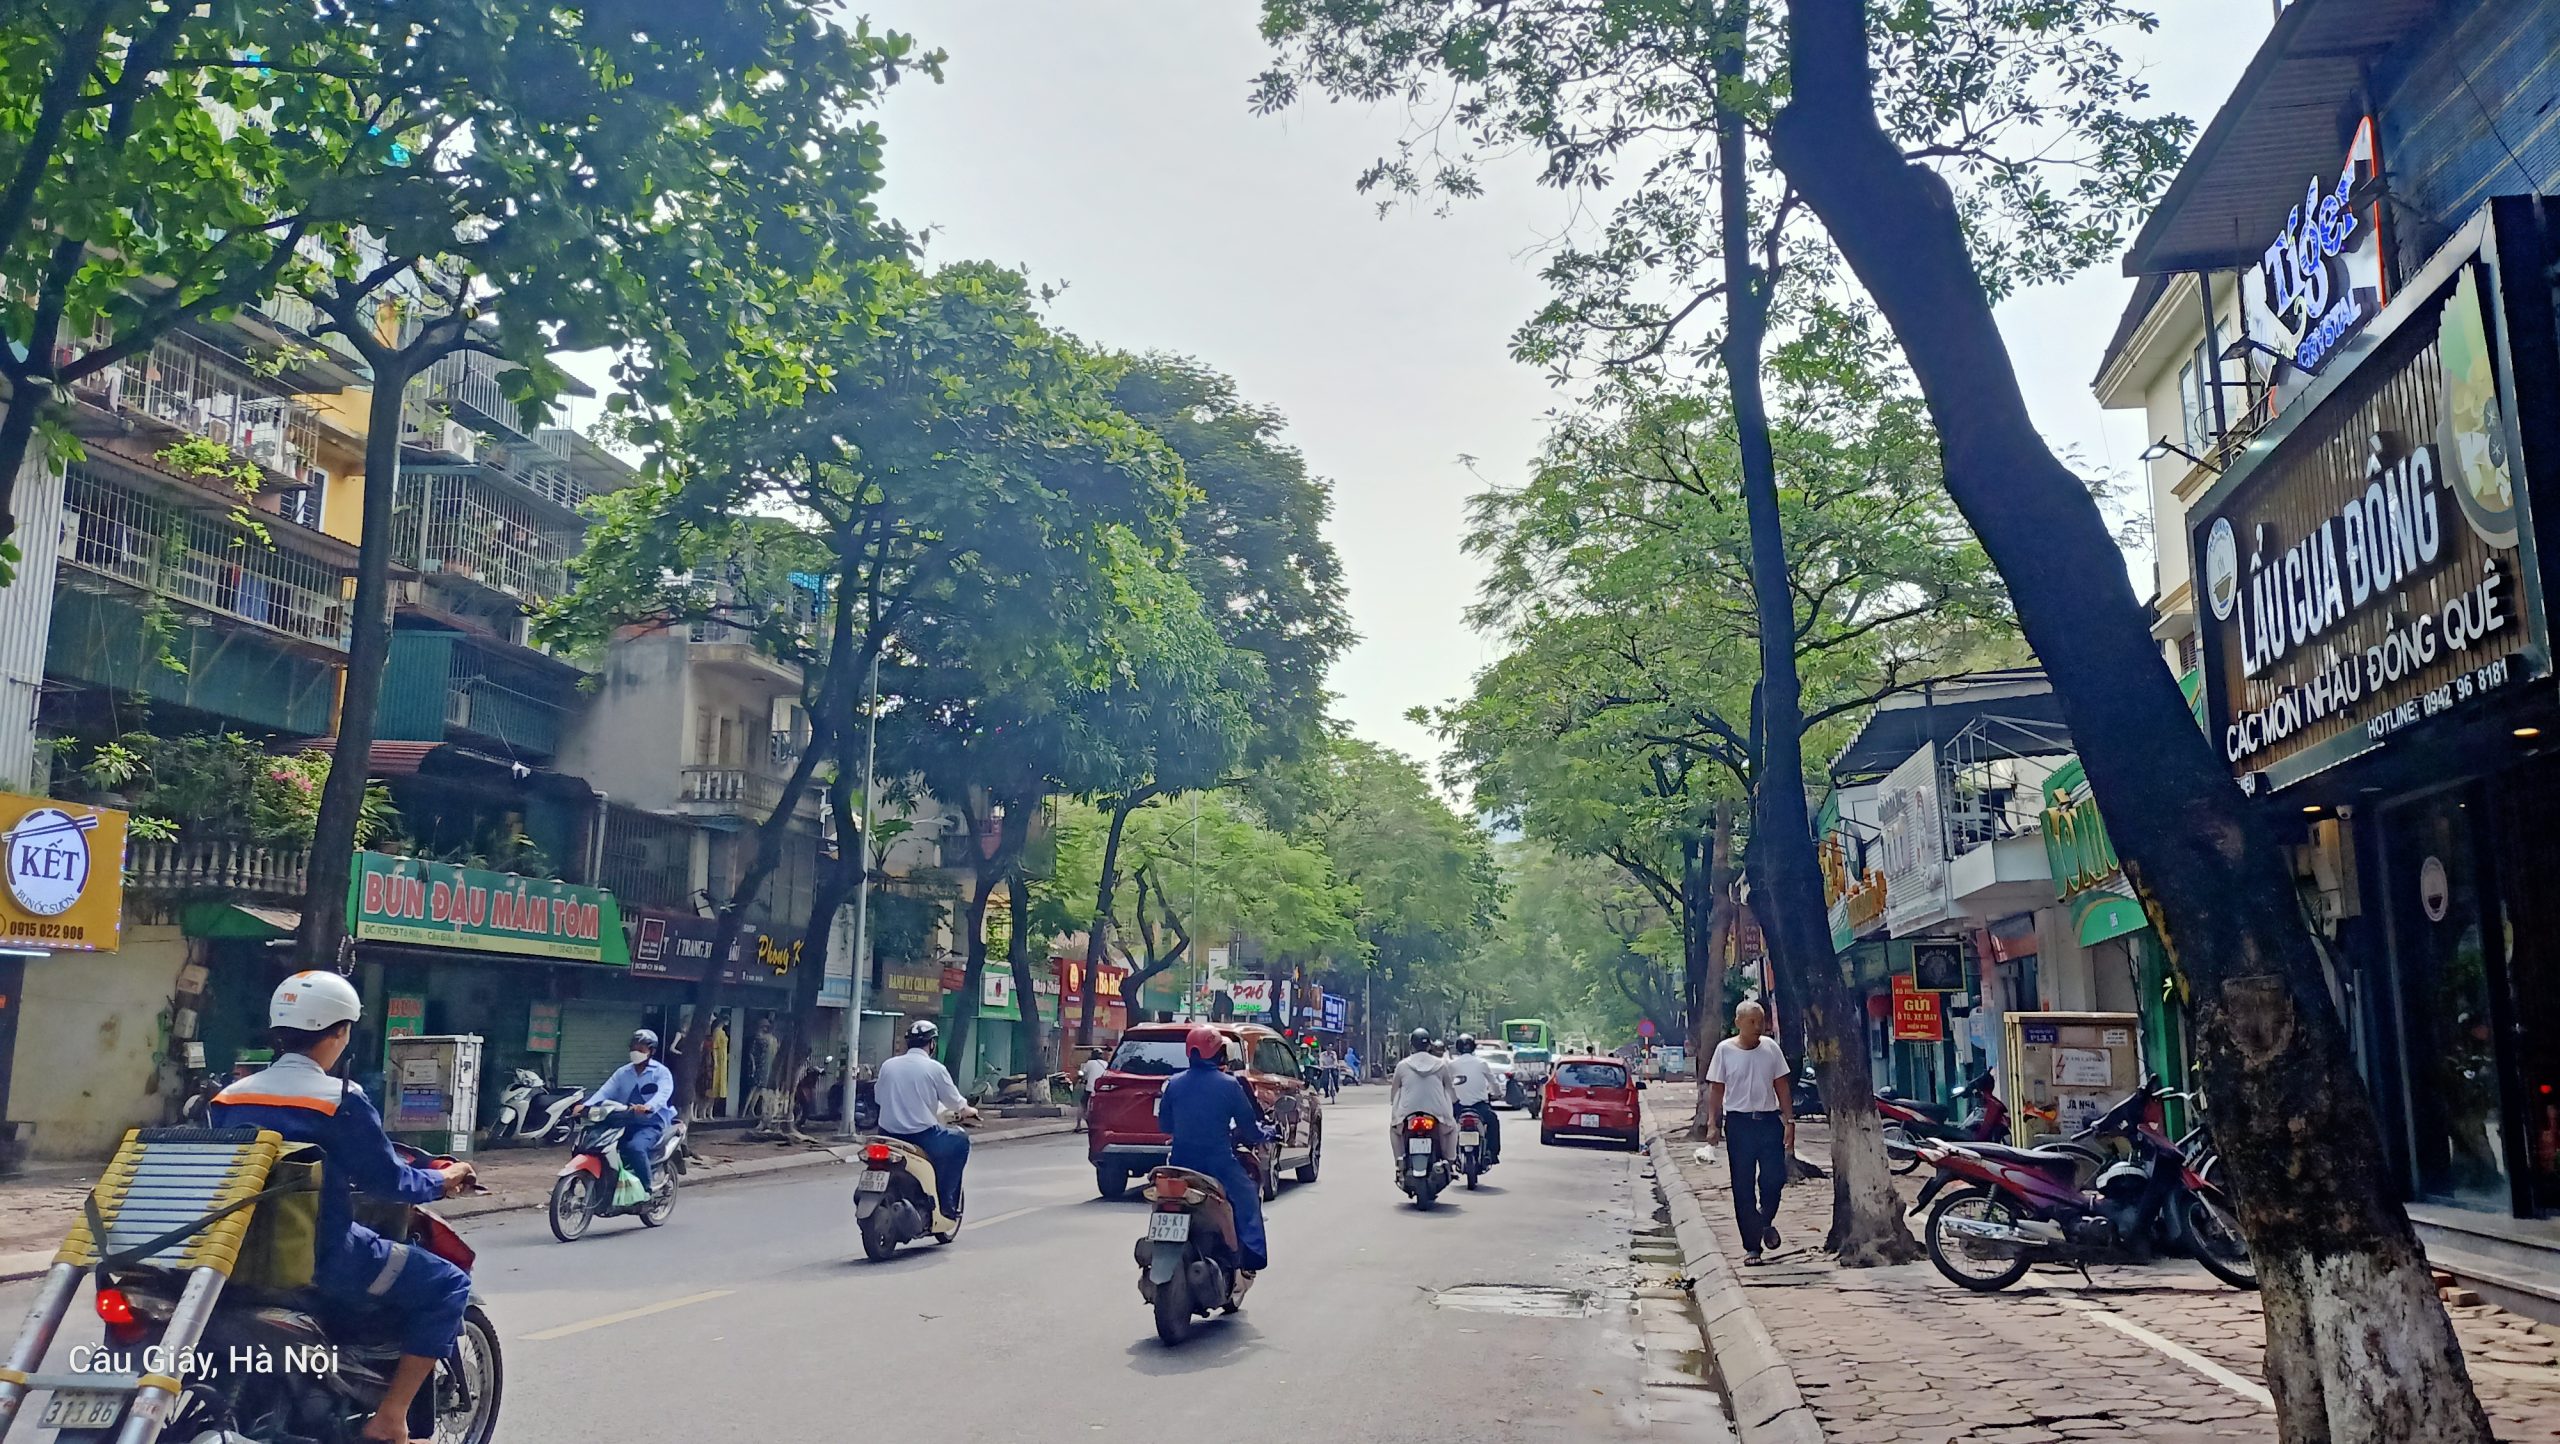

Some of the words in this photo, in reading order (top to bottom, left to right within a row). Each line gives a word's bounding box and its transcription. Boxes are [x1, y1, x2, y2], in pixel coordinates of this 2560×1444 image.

[2298, 286, 2362, 369] CRYSTAL
[2237, 523, 2286, 679] LẨU
[2286, 519, 2346, 647] CUA
[2343, 434, 2440, 609] ĐỒNG
[2227, 710, 2259, 762] CÁC
[2261, 685, 2302, 746] MÓN
[2304, 653, 2361, 723] NHẬU
[2443, 558, 2505, 651] QUÊ
[2367, 700, 2420, 739] HOTLINE:
[2423, 684, 2454, 717] 0942
[2456, 675, 2473, 701] 96
[2477, 657, 2509, 692] 8181
[19, 838, 80, 881] KẾT
[9, 921, 37, 936] 0915
[39, 923, 61, 938] 022
[364, 869, 426, 919] BÚN
[431, 873, 486, 931] ĐẬU
[490, 880, 548, 935] MẮM
[757, 934, 789, 976] Phong
[1903, 995, 1931, 1012] GỬI
